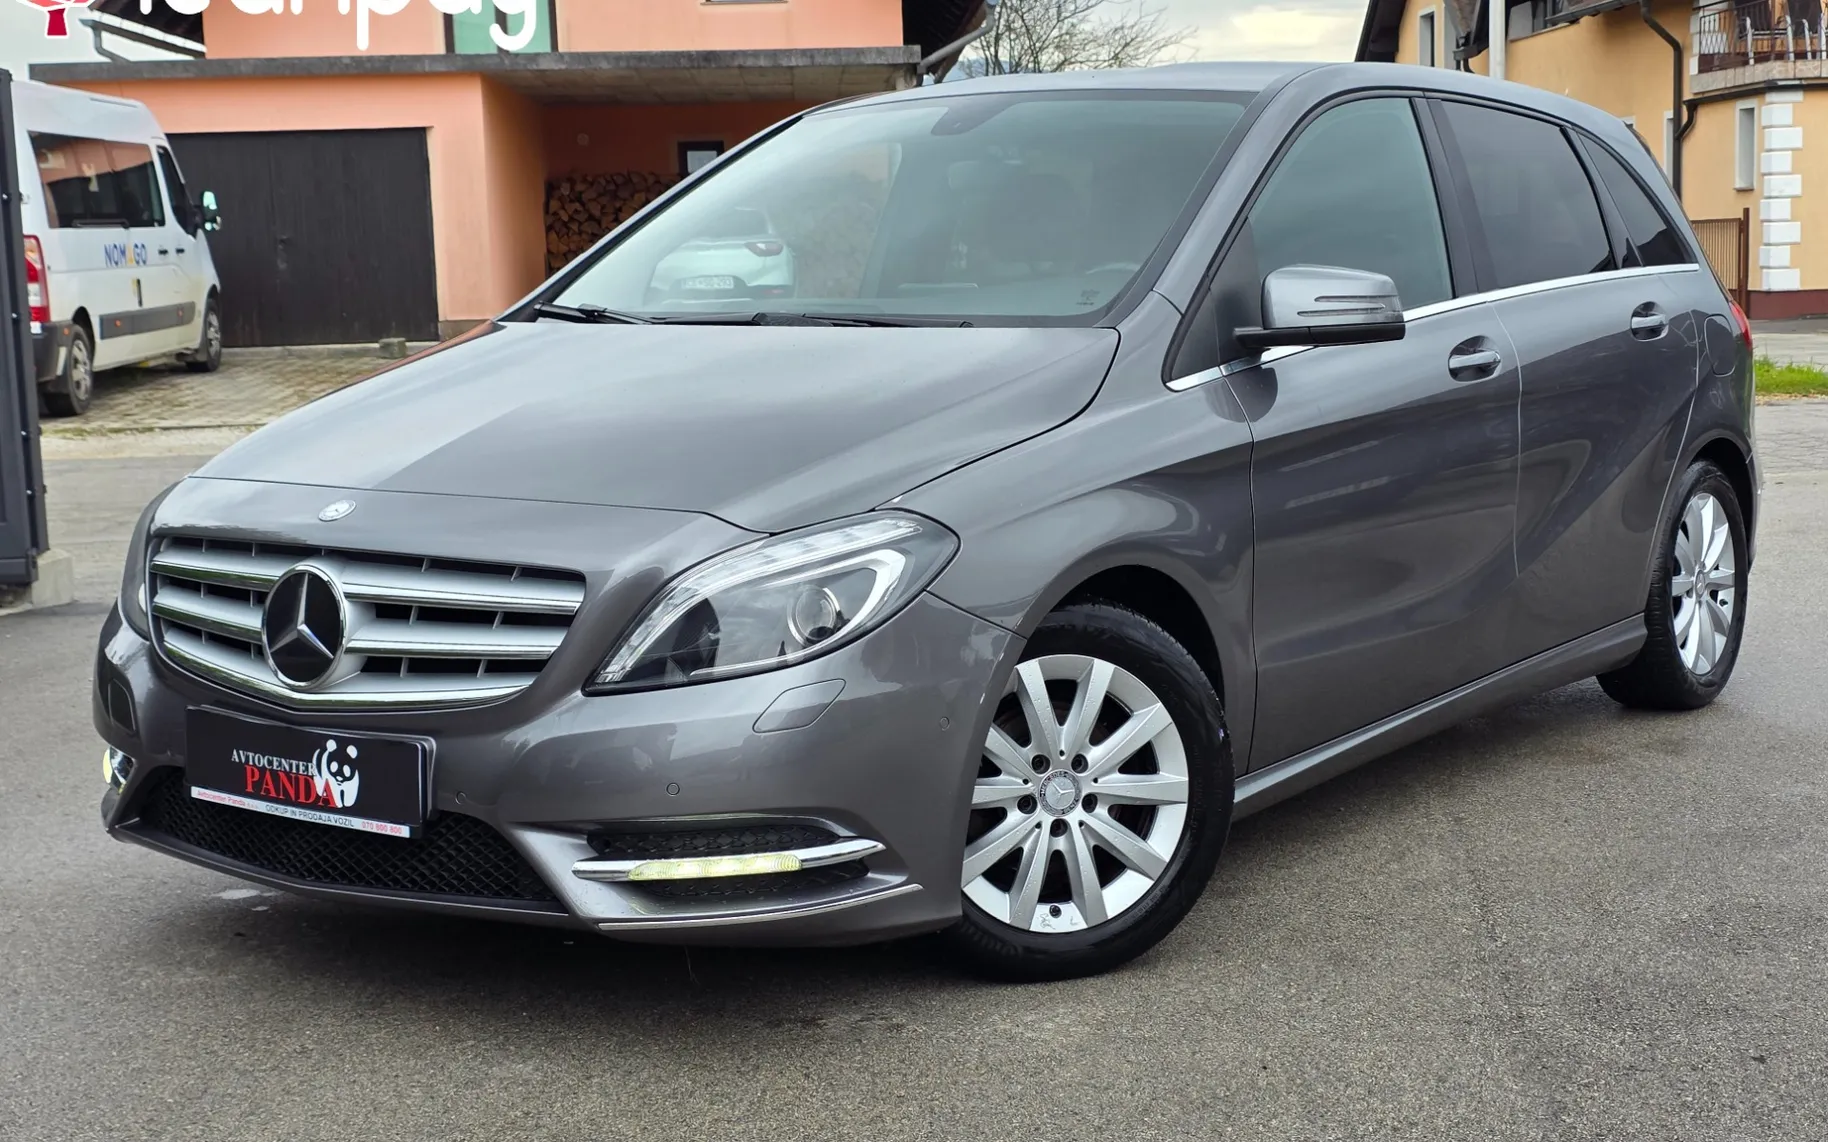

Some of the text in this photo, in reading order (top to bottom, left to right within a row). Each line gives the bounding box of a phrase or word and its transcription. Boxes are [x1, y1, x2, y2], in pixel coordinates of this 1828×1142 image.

[231, 748, 317, 776] AVTOCENTER
[245, 764, 337, 808] PANDA
[265, 804, 288, 815] ODKUP
[290, 809, 298, 817] IN
[298, 811, 333, 823] PRODAJA
[333, 817, 355, 828] VOZIL
